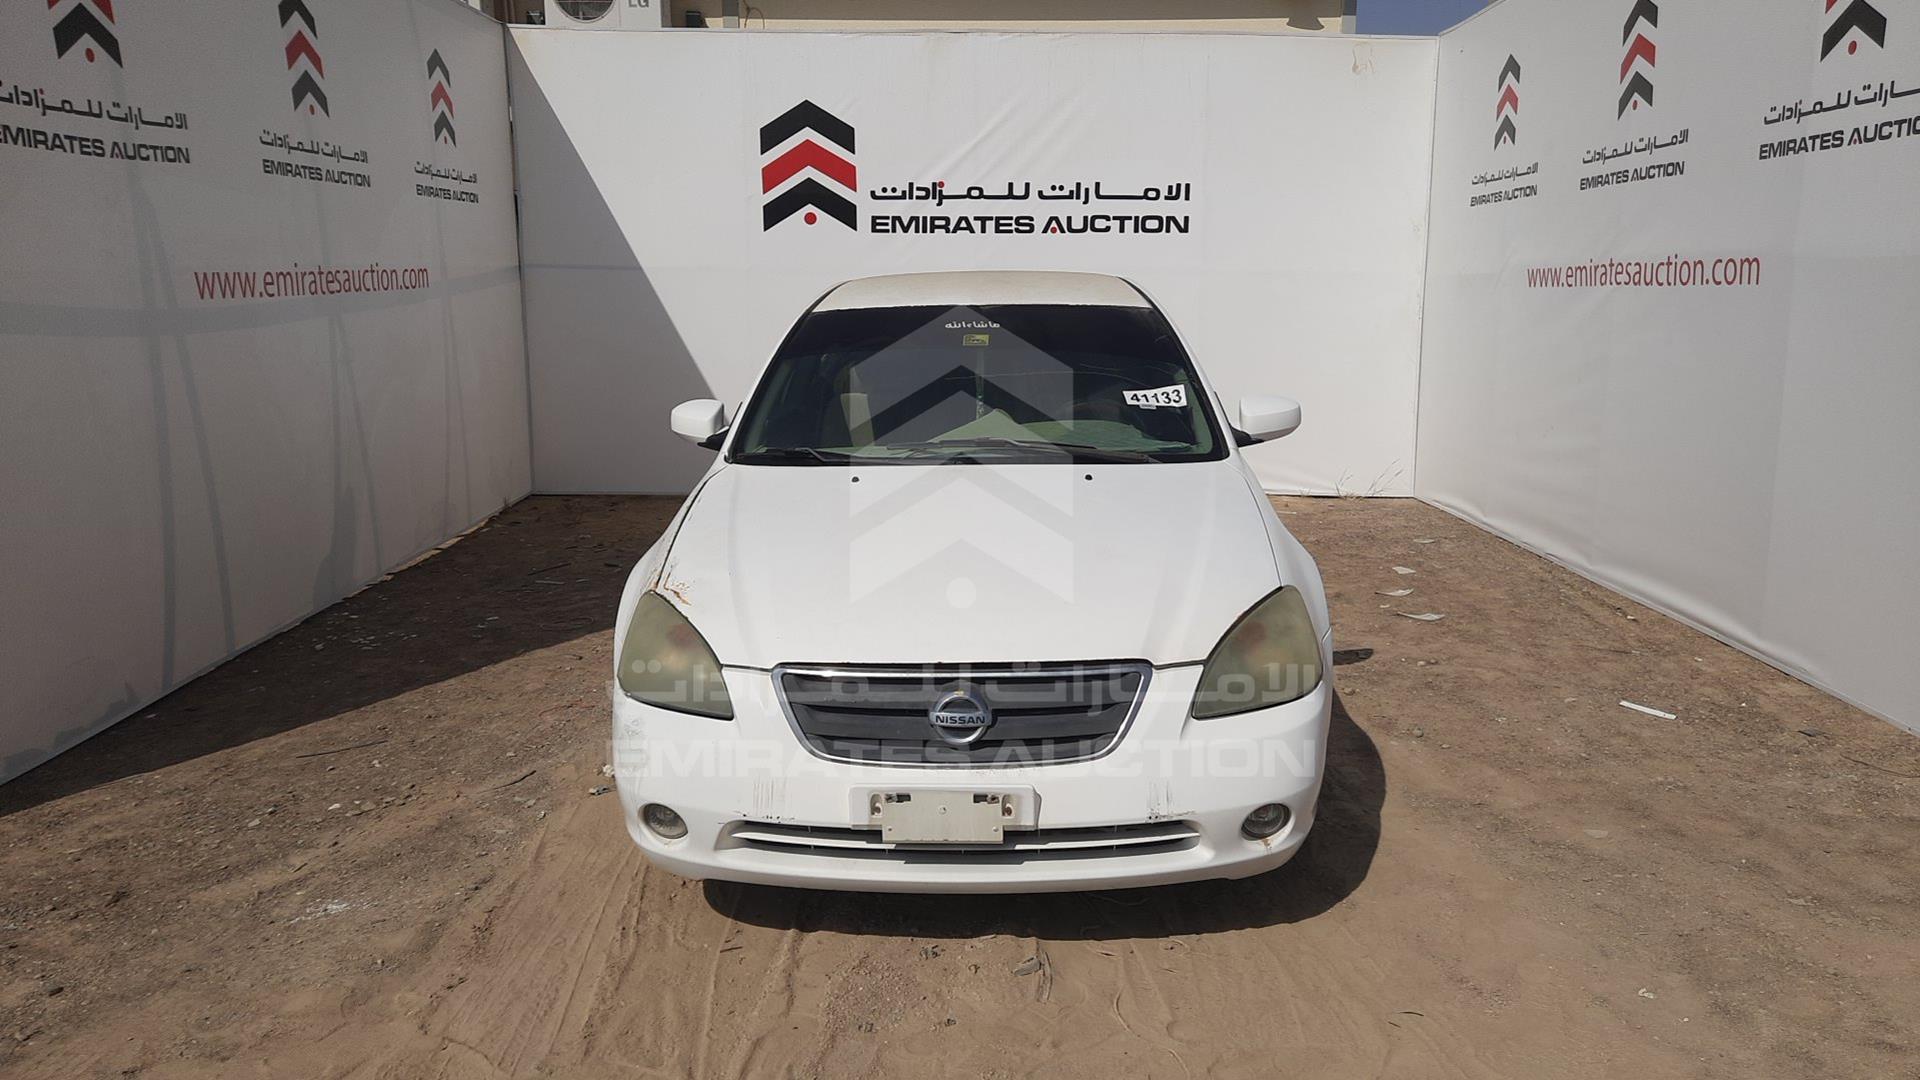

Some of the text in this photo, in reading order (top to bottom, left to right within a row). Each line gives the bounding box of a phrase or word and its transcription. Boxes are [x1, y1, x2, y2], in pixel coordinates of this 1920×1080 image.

[0, 124, 190, 164] MIRATES AUCTION
[1759, 129, 1845, 160] EMIRATES
[262, 158, 371, 188] EMIRATES AUCTION
[1580, 161, 1685, 191] EMIRATES AUCTION
[416, 184, 479, 204] EMIRATES AUCTION
[1470, 184, 1538, 207] EMIRATES AUCTION
[870, 214, 1190, 234] EMIRATES AUCTION
[194, 262, 430, 300] www.emiratesauction.com
[1527, 254, 1761, 288] www.emiratesauction.com
[1130, 388, 1182, 405] 41133
[935, 715, 986, 725] NISSAN
